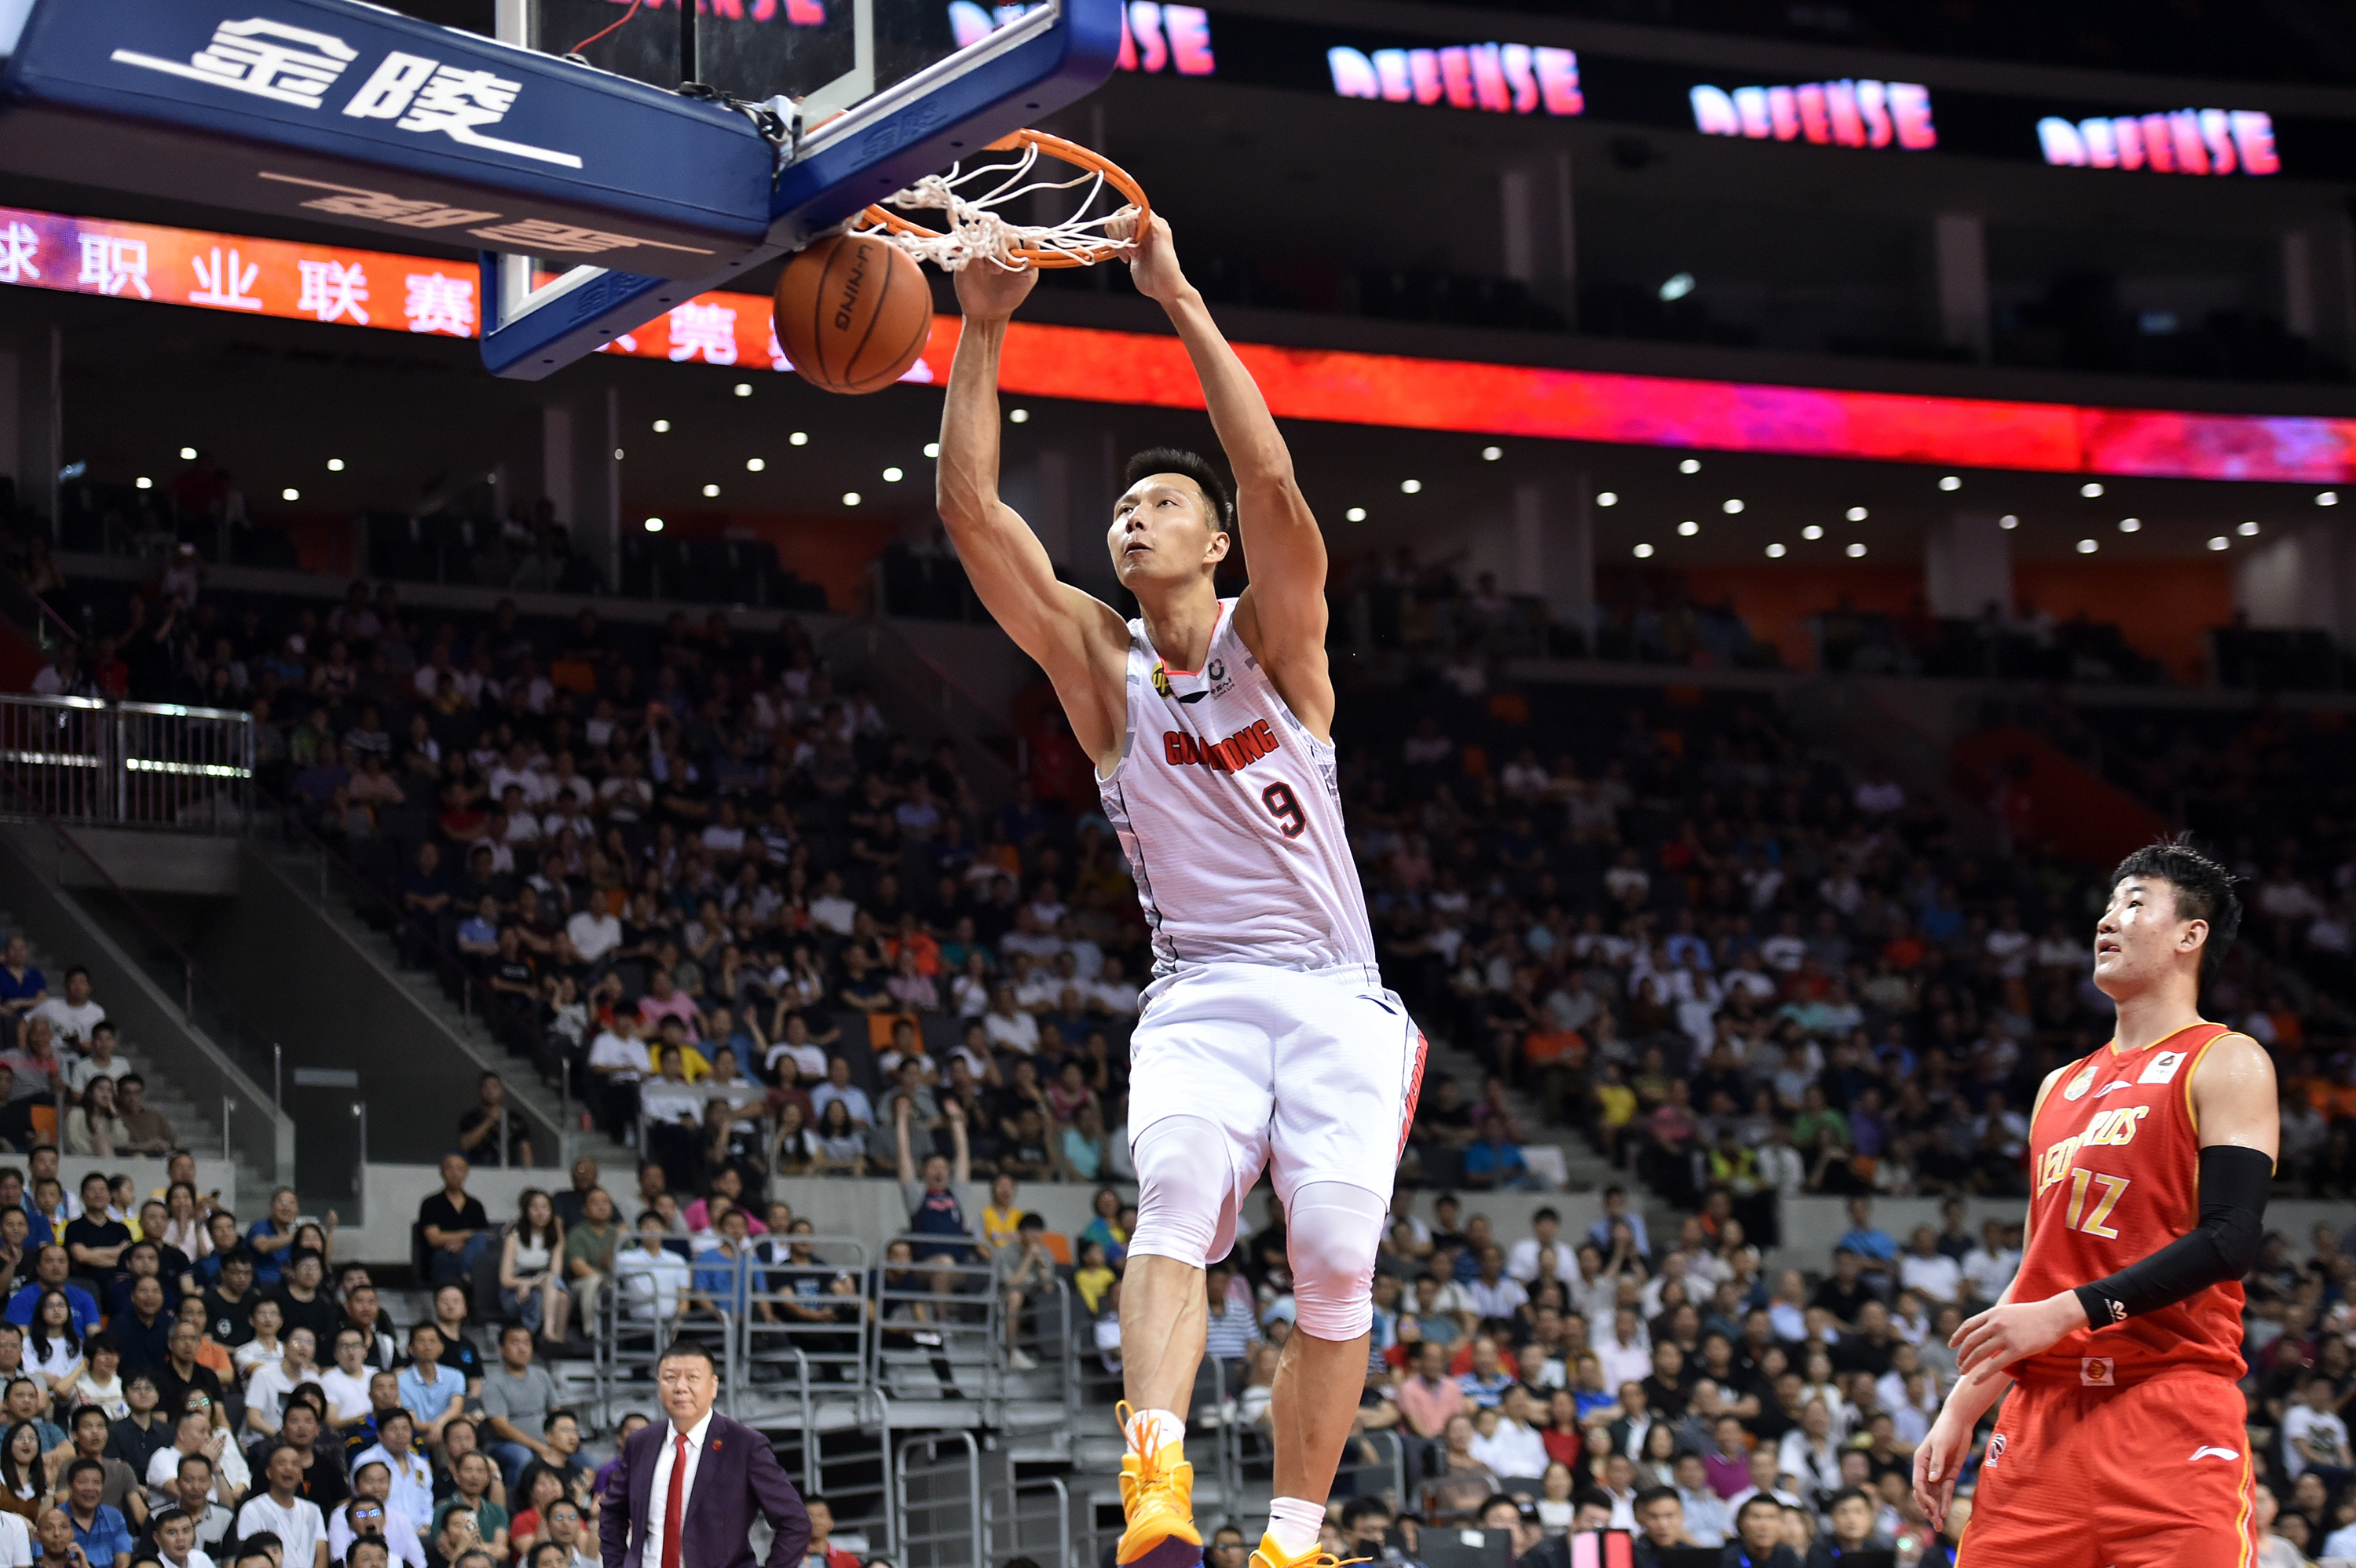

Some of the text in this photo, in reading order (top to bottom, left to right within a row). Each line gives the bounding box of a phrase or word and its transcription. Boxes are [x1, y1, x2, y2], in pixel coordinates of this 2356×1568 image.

[111, 17, 584, 169] 金陵
[835, 244, 873, 331] LI-NING
[1261, 780, 1307, 840] 9
[2037, 1106, 2150, 1200] LEORDS
